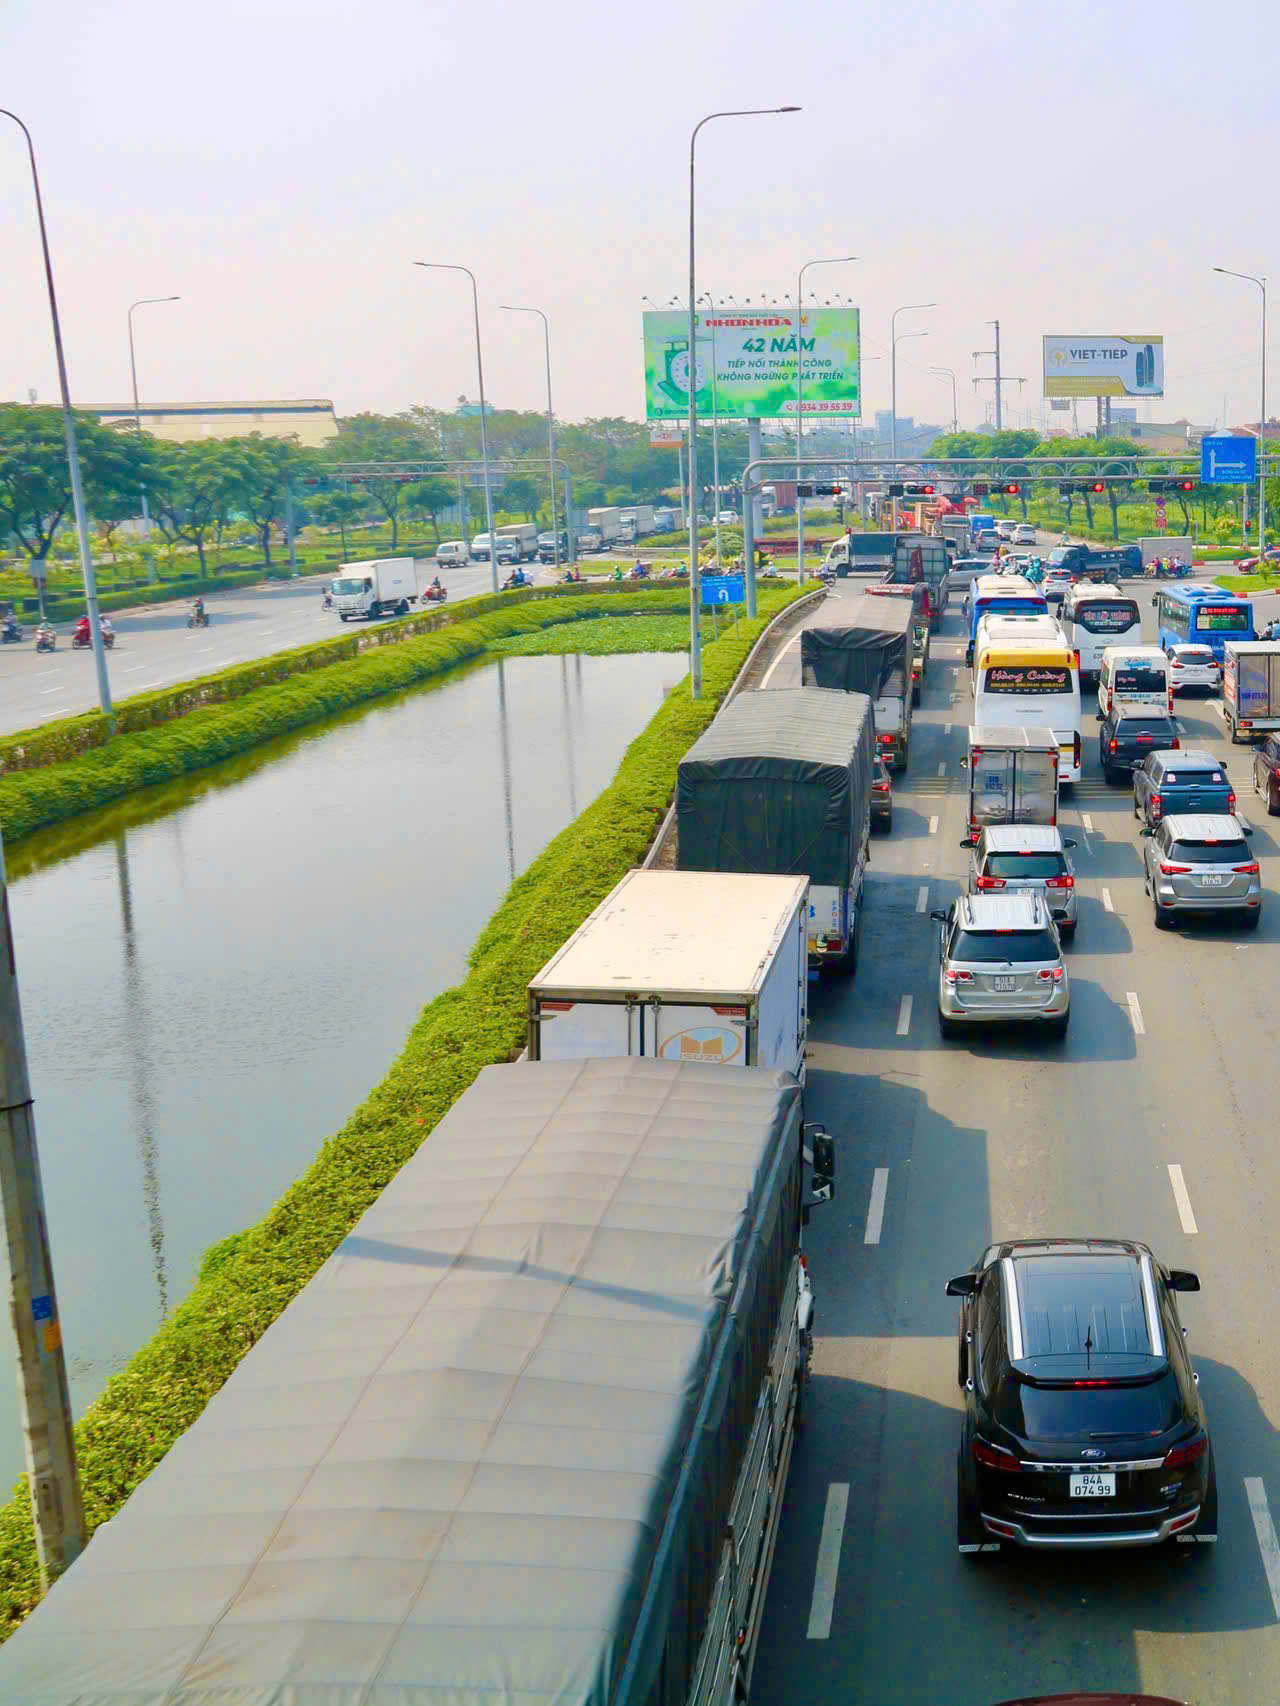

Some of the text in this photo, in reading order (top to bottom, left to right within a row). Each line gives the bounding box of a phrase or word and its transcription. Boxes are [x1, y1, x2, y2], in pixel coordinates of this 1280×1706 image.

[742, 333, 816, 353] 42 NĂM
[1070, 349, 1128, 360] VIET-TIEP
[727, 357, 832, 368] TIẾP NỐI THÀNH CÔNG
[716, 370, 752, 381] KHÔNG
[818, 367, 844, 381] TRIỂN
[818, 402, 829, 411] 39
[830, 402, 841, 411] 55
[841, 402, 852, 411] 39
[1082, 1475, 1103, 1485] 84A
[1074, 1485, 1111, 1496] 074.99
